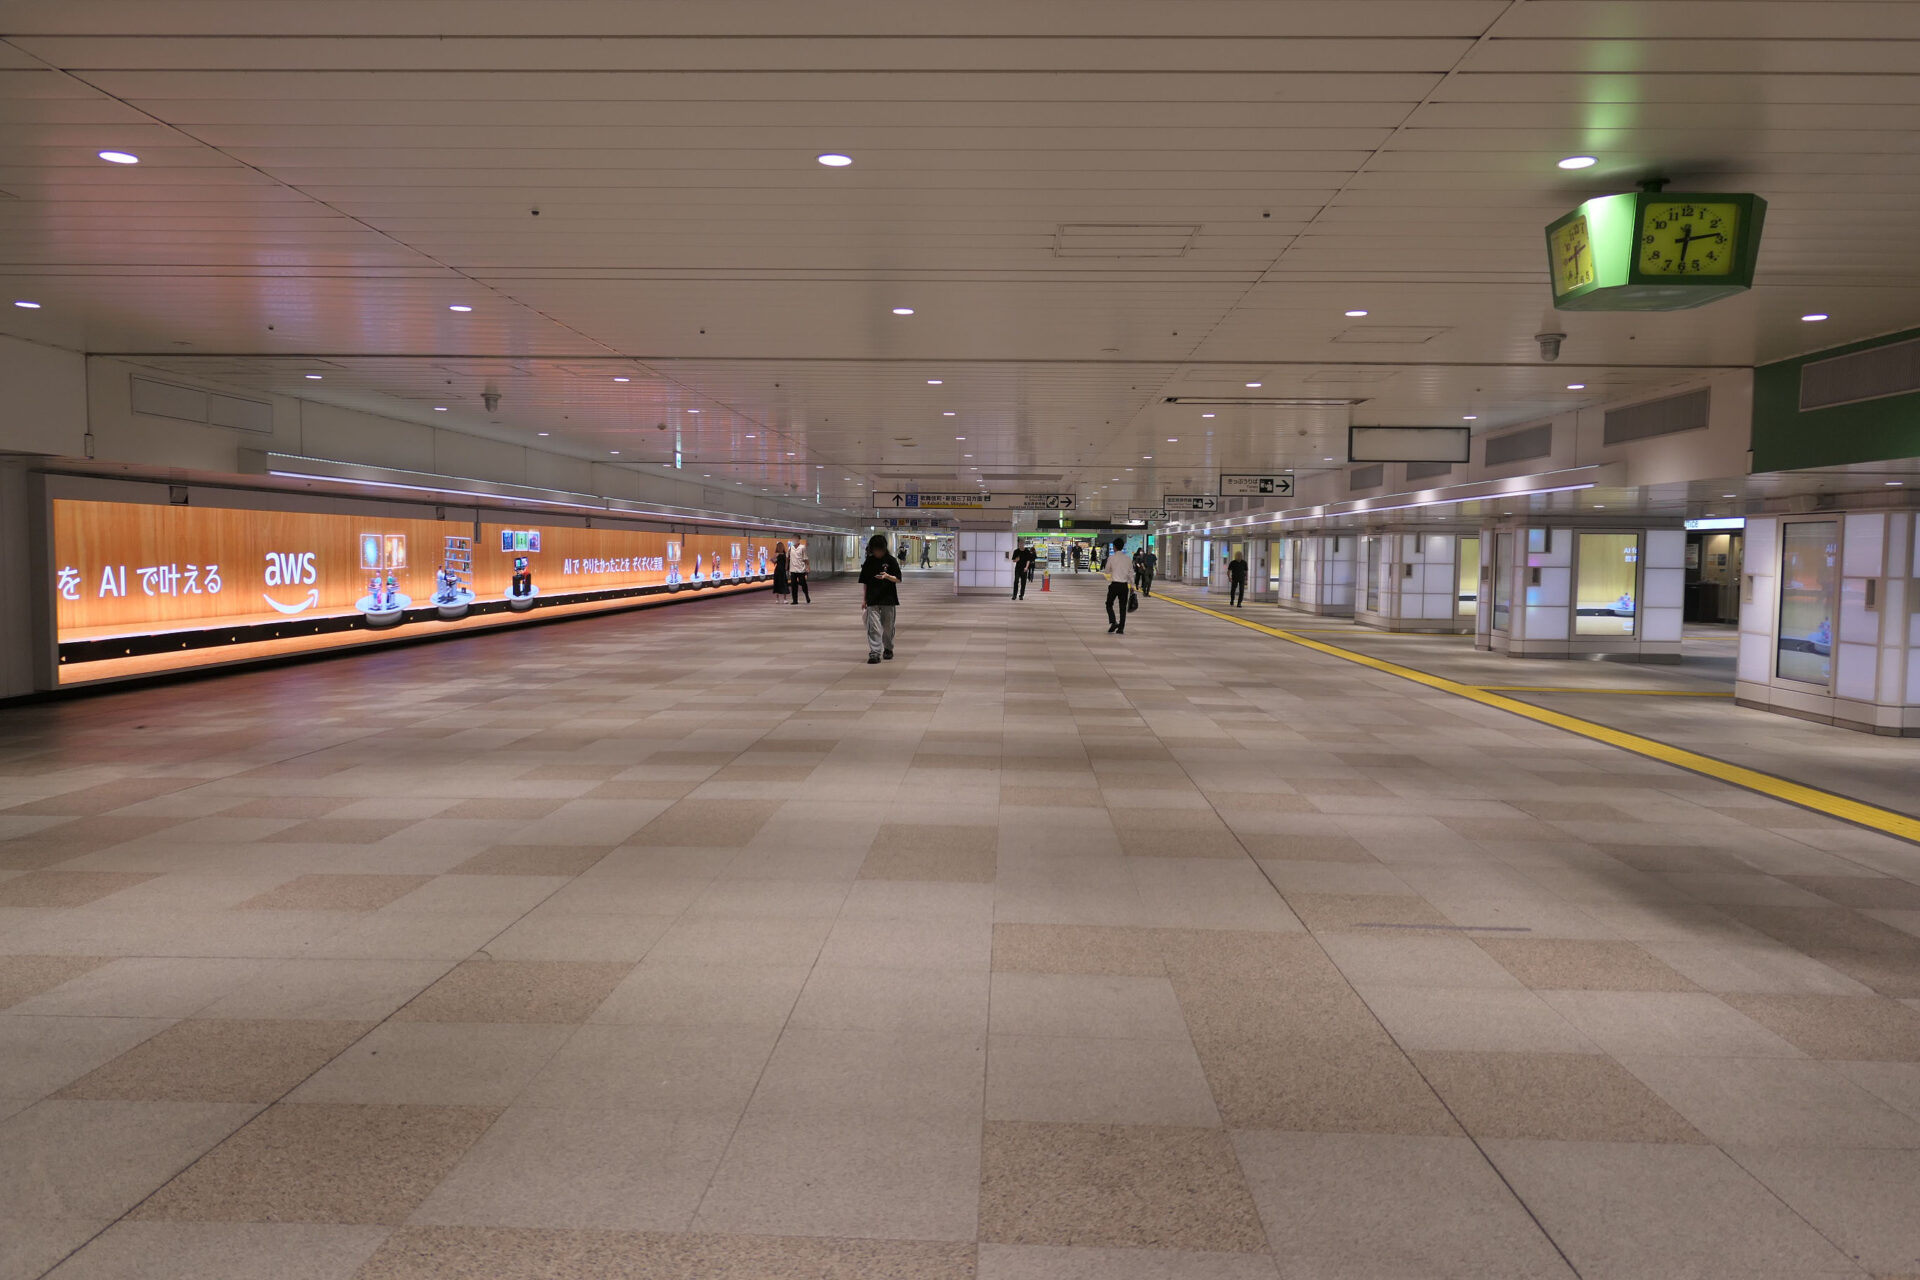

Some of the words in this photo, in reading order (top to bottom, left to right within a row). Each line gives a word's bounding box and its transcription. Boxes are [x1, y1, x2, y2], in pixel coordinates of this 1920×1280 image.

[1668, 211, 1680, 222] 11
[1682, 207, 1695, 217] 12
[1699, 211, 1705, 220] 1
[1654, 220, 1667, 230] 10
[1710, 219, 1719, 229] 2
[1646, 235, 1655, 244] 9
[1715, 234, 1724, 244] 3
[1652, 250, 1661, 260] 8
[1706, 250, 1714, 260] 4
[1664, 259, 1673, 268] 7
[1677, 262, 1686, 271] 6
[1691, 259, 1700, 269] 5
[264, 552, 317, 586] aws
[582, 557, 631, 575] やりたかったことを
[57, 566, 81, 600] を
[99, 565, 126, 598] AI
[136, 563, 222, 597] で叶える
